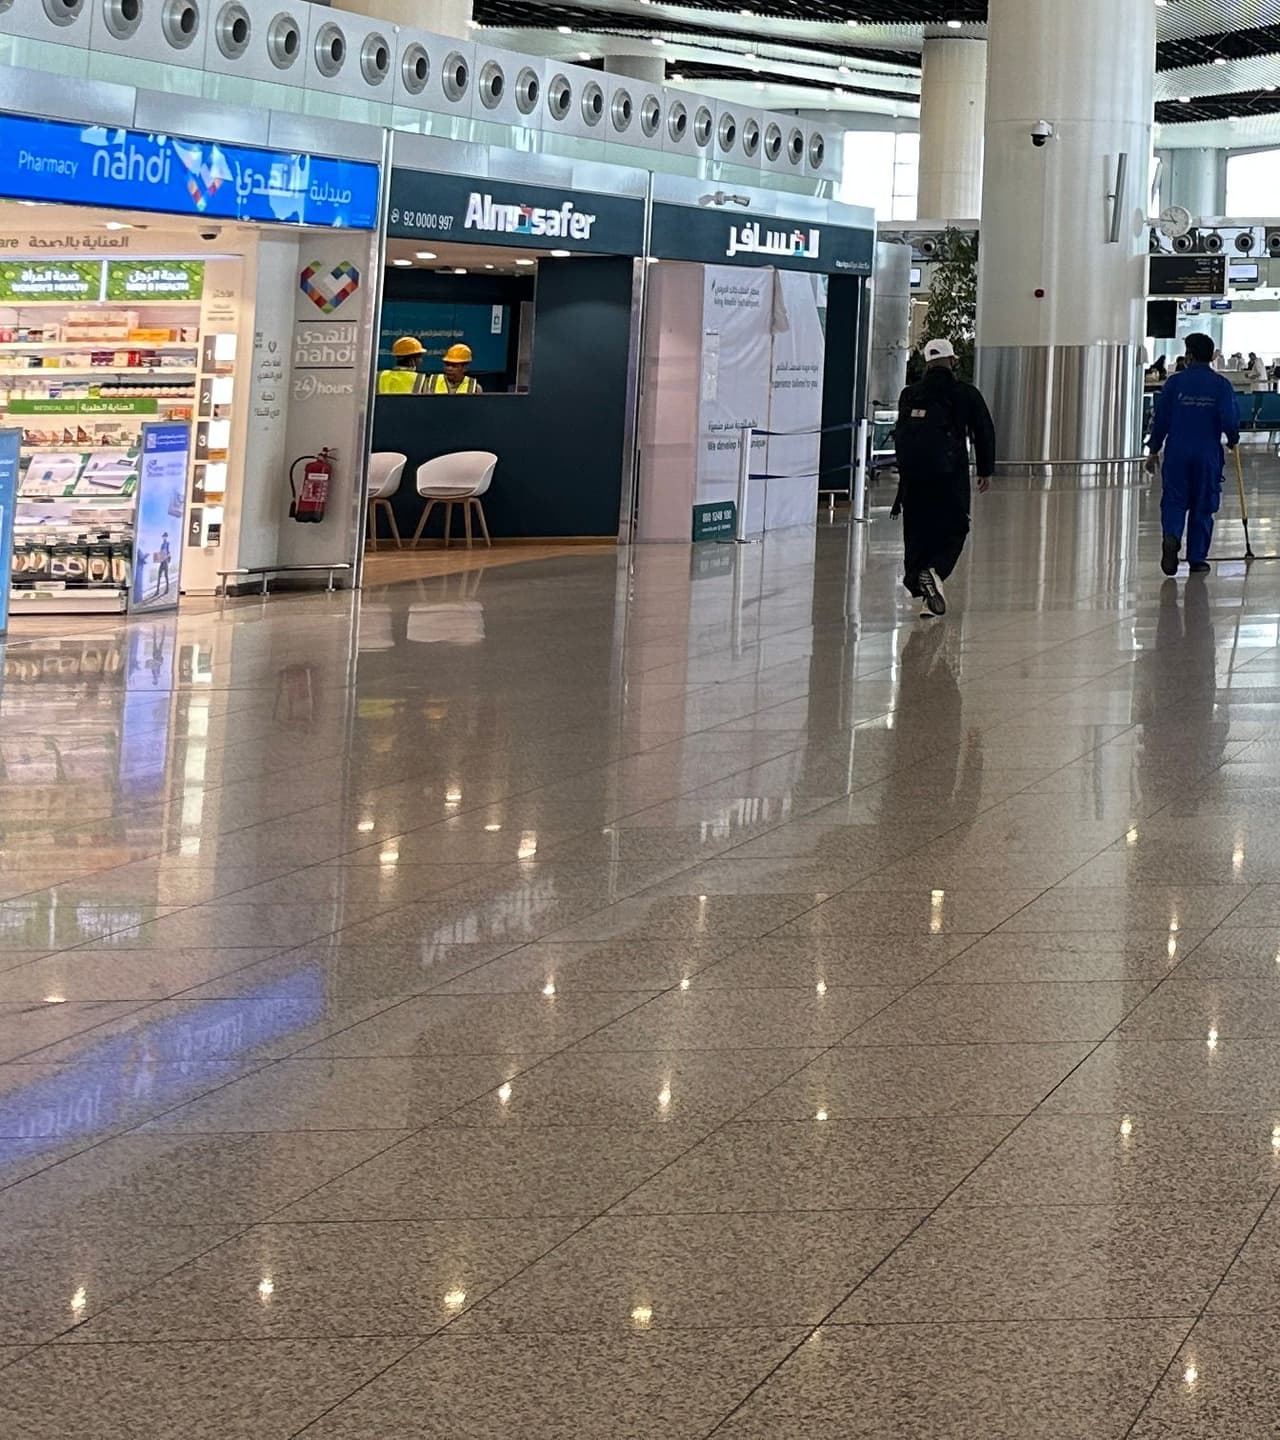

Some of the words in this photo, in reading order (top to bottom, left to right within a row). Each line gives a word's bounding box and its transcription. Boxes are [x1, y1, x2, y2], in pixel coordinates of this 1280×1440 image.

[18, 150, 79, 178] Pharmacy
[92, 145, 171, 184] nahdi
[310, 179, 352, 207] صيدلية
[403, 211, 415, 227] 92
[415, 213, 437, 229] 0000
[438, 215, 454, 231] 997
[464, 192, 596, 240] Almosafer
[0, 238, 19, 248] are
[29, 236, 79, 250] بالصحة
[82, 236, 129, 250] العناية
[725, 222, 820, 259] المسافر
[295, 345, 356, 363] nahdi
[317, 382, 353, 395] hours
